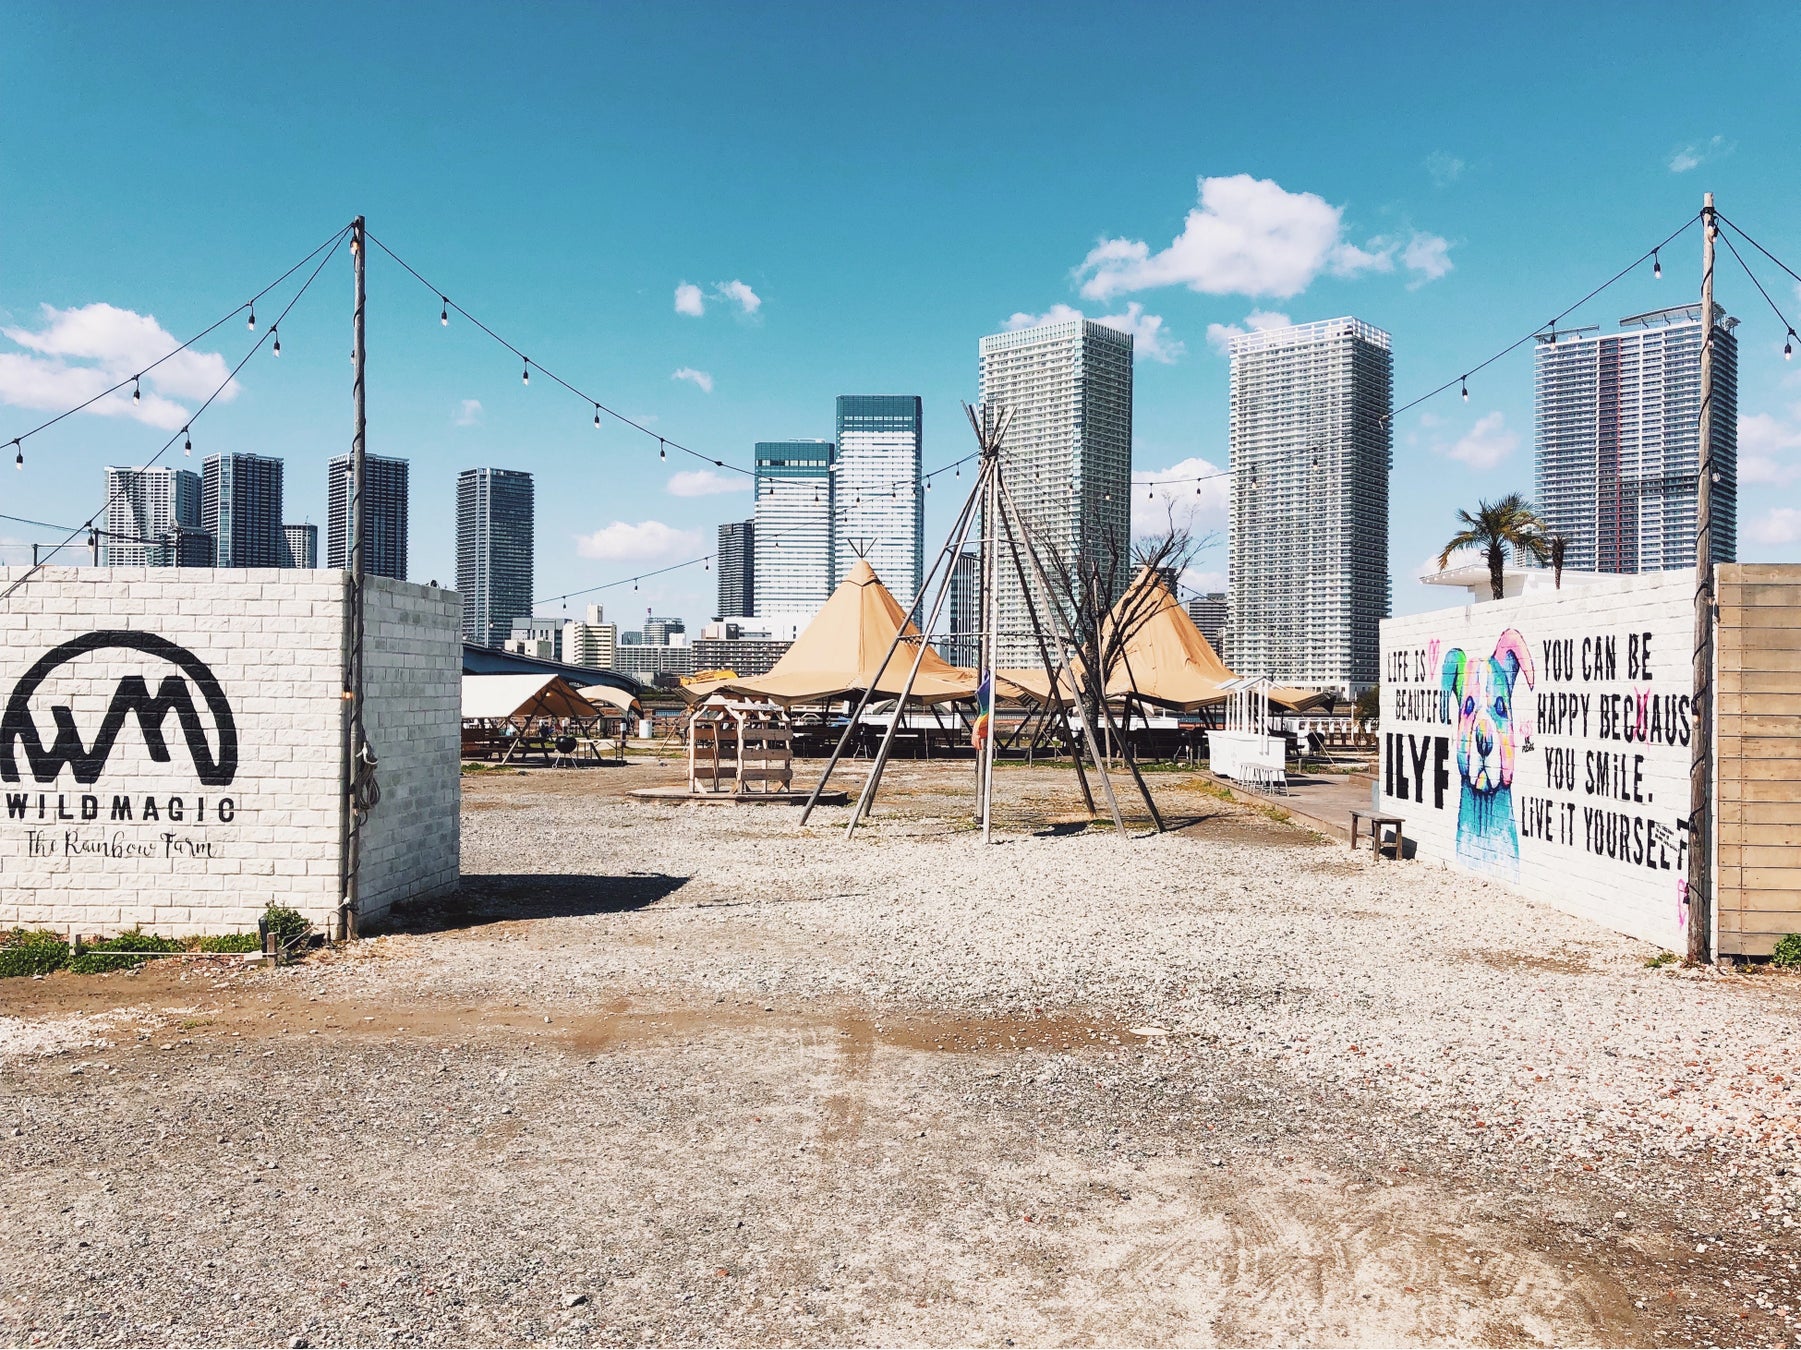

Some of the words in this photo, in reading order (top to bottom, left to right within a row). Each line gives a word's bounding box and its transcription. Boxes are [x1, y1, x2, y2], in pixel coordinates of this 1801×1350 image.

[1387, 650, 1408, 682] LIFE
[1414, 649, 1426, 682] IS
[1543, 638, 1573, 682] YOU
[1582, 635, 1616, 682] CAN
[1628, 632, 1653, 681] BE
[1395, 689, 1452, 725] BEAUTIFUL
[1537, 692, 1590, 738] HAPPY
[1386, 732, 1449, 810] ILYF
[1545, 746, 1575, 791] YOU
[6, 793, 235, 823] WILDMAGIC
[24, 830, 57, 858] The
[65, 830, 156, 858] Rainbow
[160, 832, 218, 858] Farm
